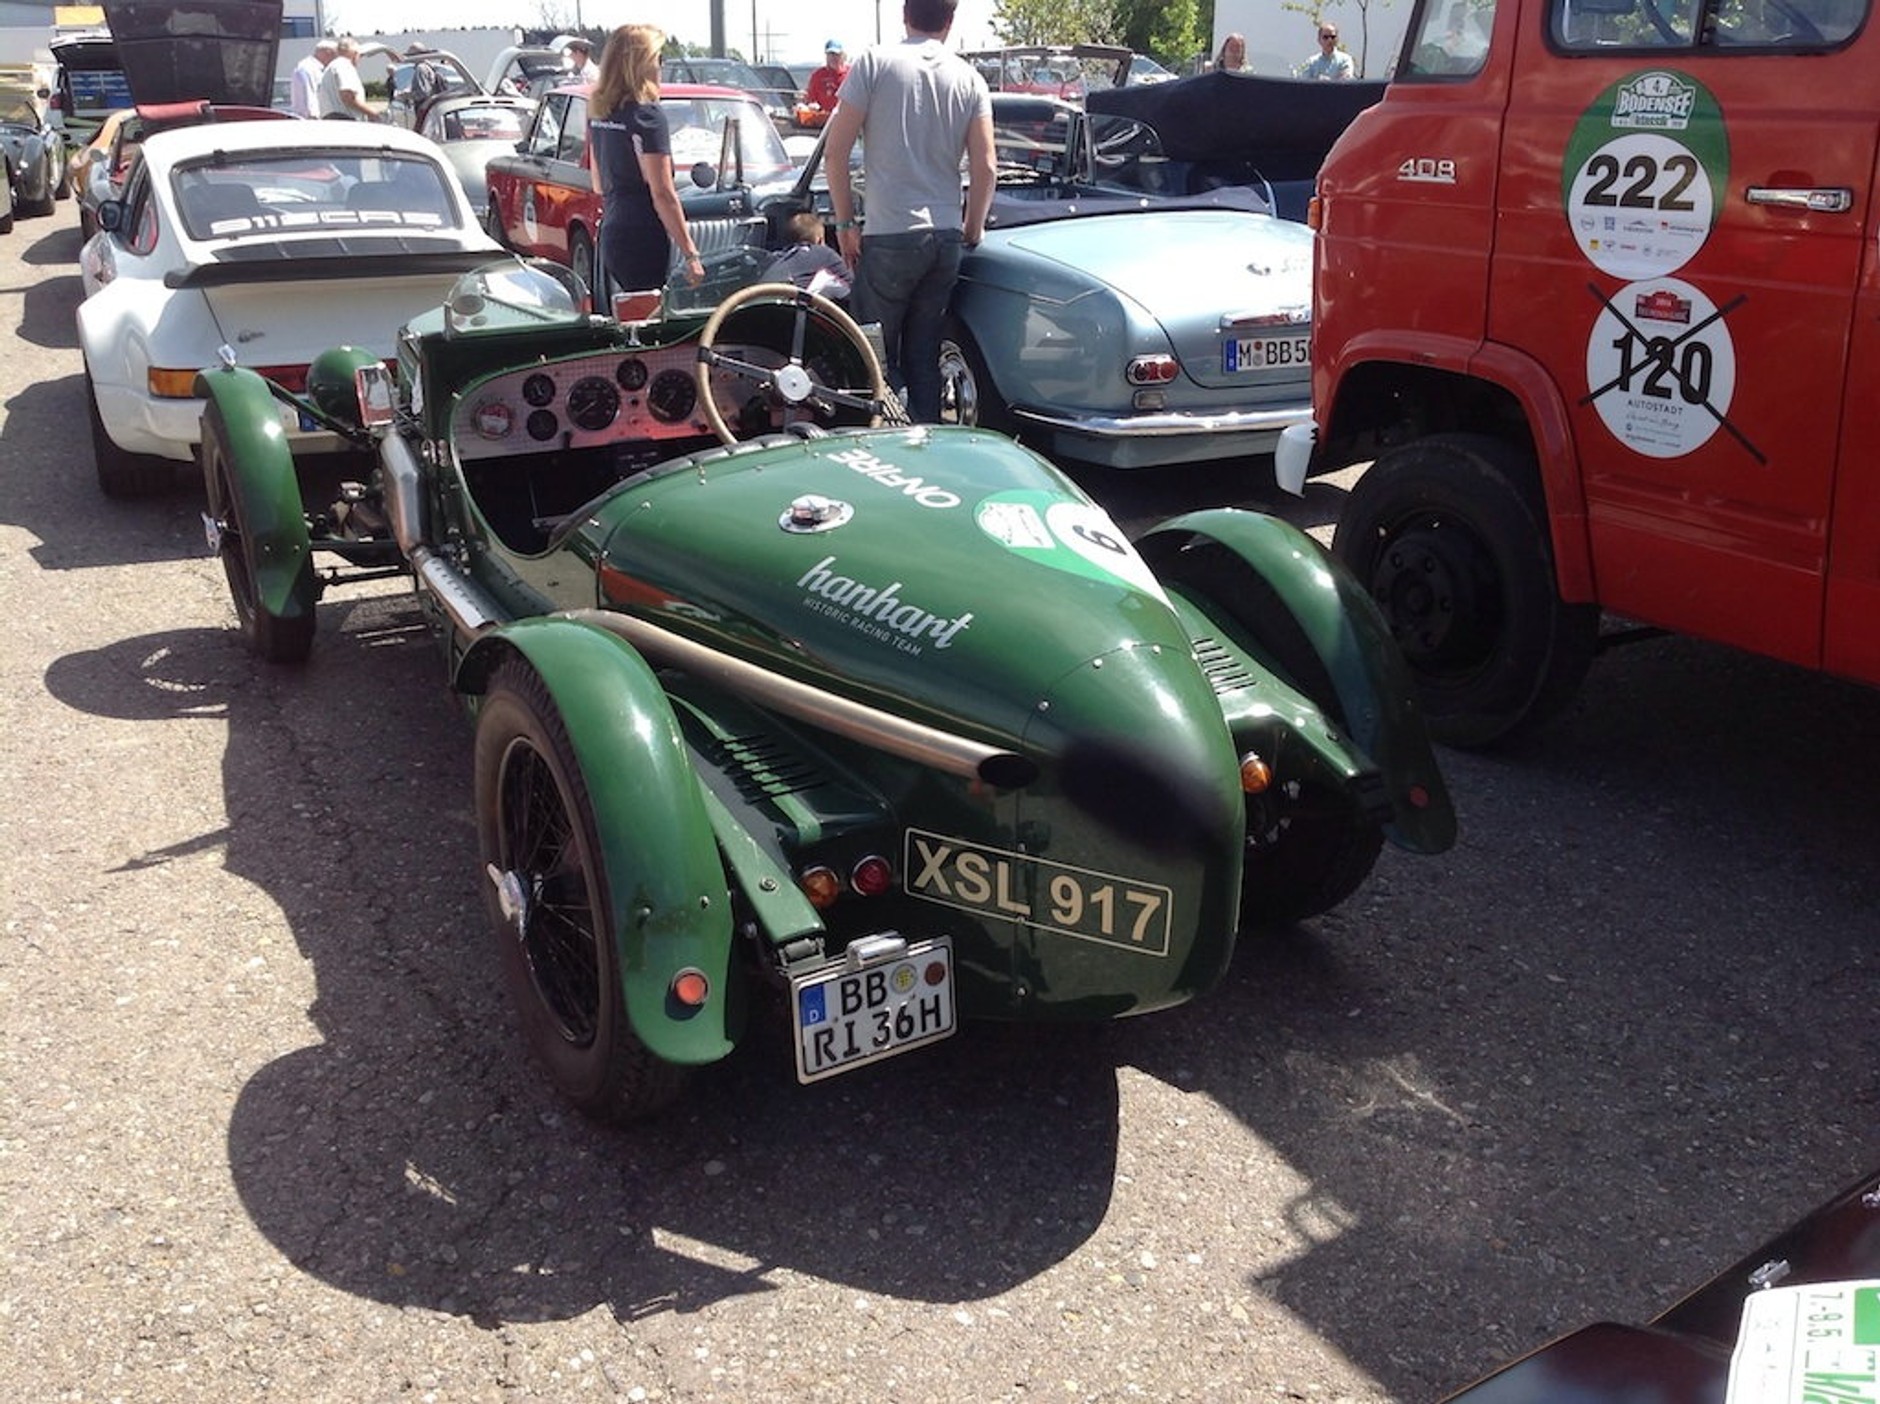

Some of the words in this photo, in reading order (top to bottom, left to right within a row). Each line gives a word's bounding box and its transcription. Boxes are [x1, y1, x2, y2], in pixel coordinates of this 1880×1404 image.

[1617, 89, 1691, 117] BODENSEE
[1398, 158, 1456, 180] 408
[1583, 154, 1698, 211] 222
[1238, 342, 1252, 367] M
[1612, 331, 1713, 406] 120
[1627, 399, 1684, 416] AUTOSTADT
[826, 448, 961, 508] ONFIRE
[796, 555, 974, 649] hanhart
[803, 597, 850, 625] HISTORIC
[850, 616, 889, 642] RACING
[891, 636, 923, 656] TEAM
[914, 839, 1032, 916] XSL
[1050, 874, 1162, 941] 917
[840, 970, 889, 1017] BB
